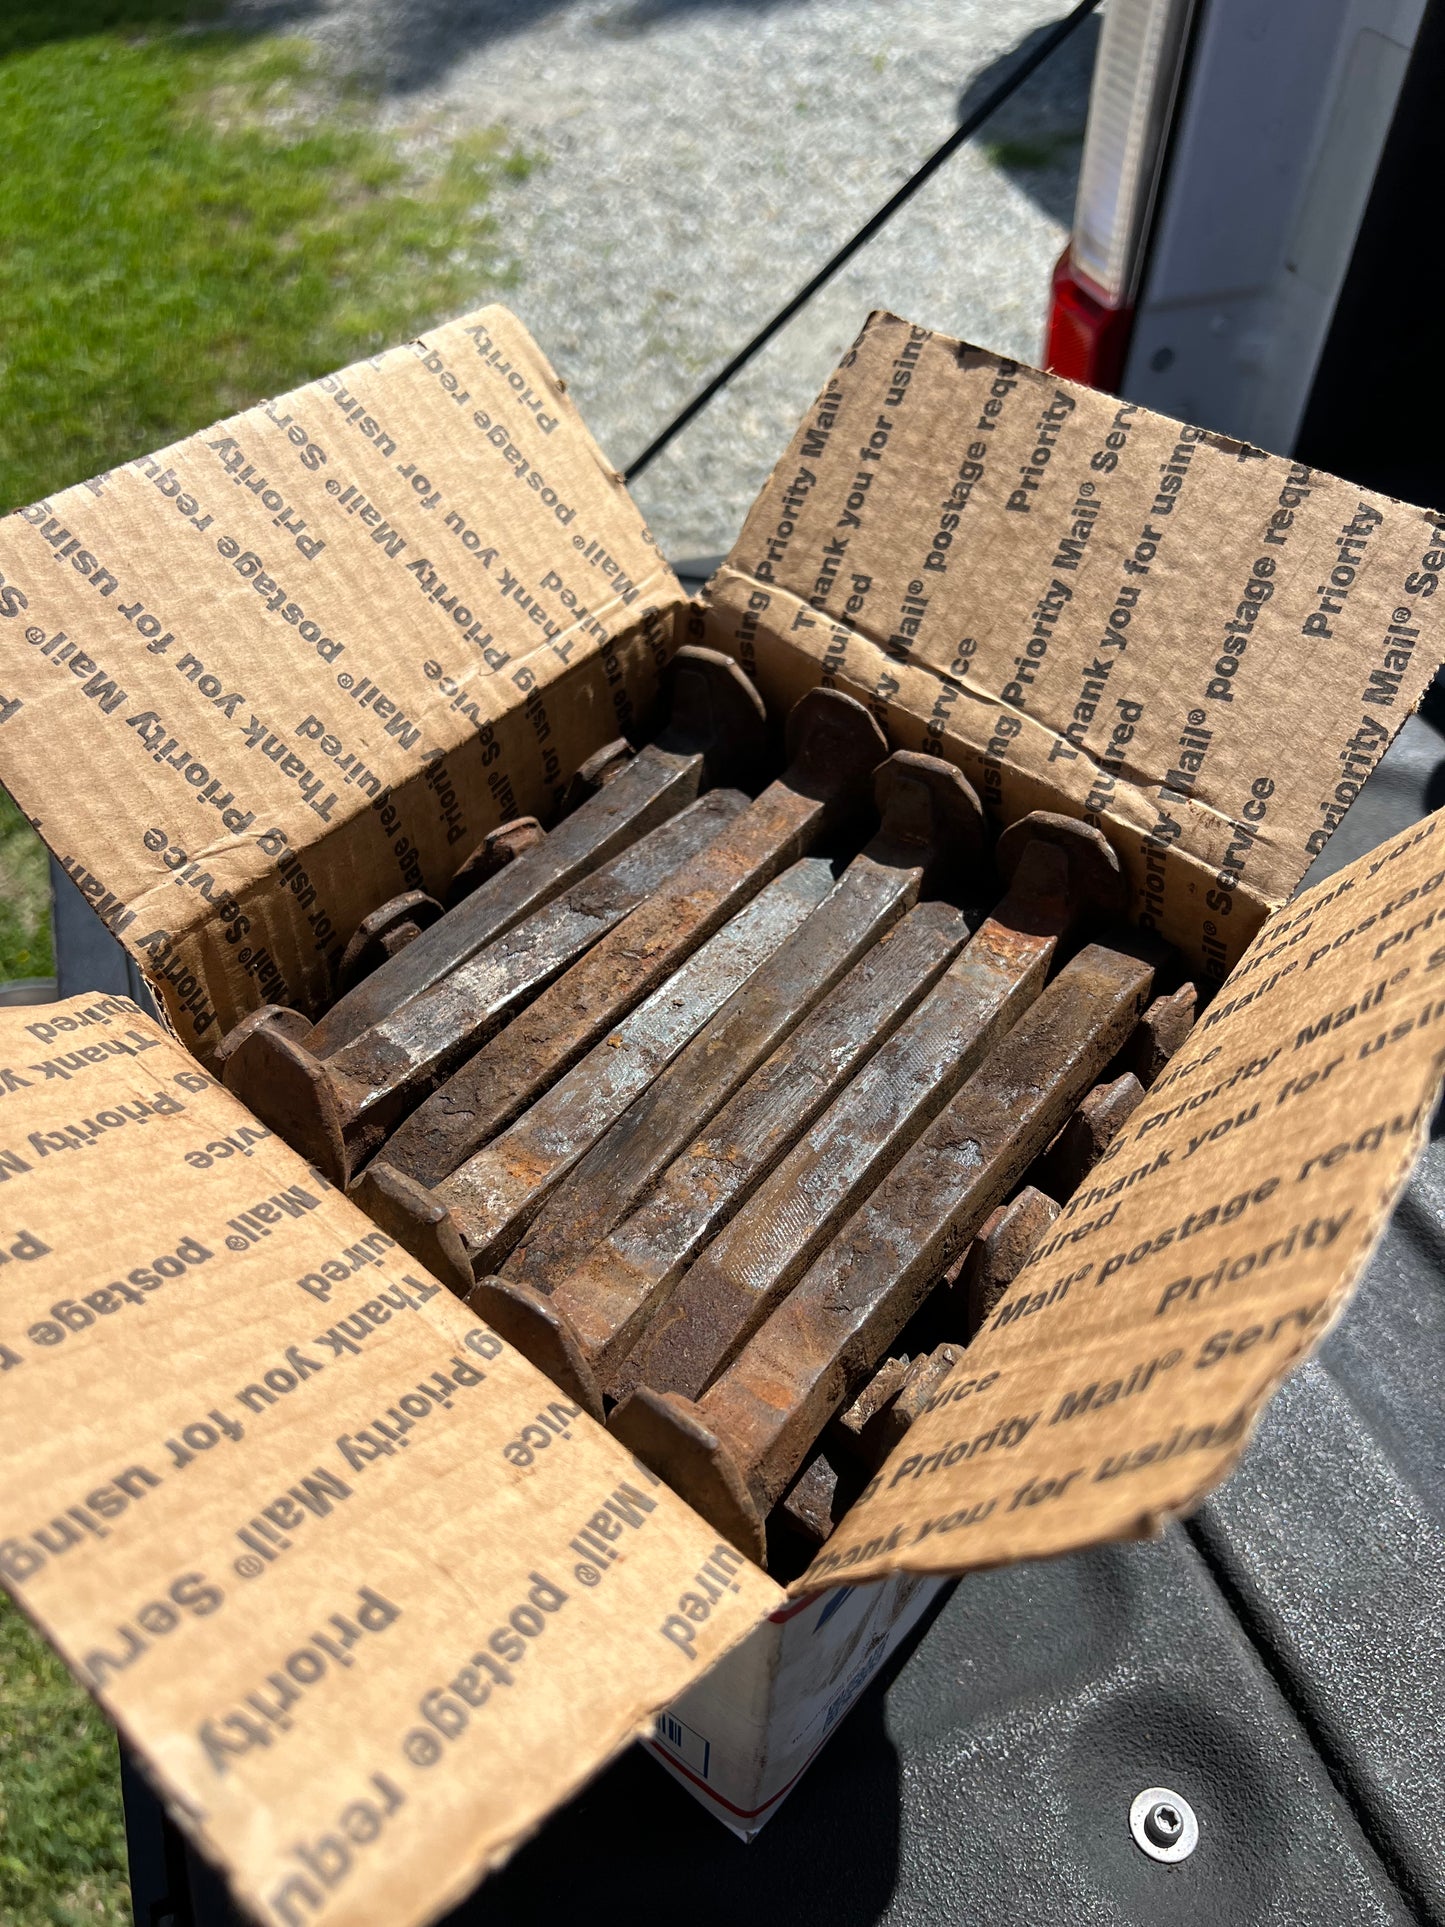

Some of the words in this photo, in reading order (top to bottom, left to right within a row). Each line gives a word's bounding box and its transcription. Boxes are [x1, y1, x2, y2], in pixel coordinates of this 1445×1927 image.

[465, 324, 560, 435] Priority
[837, 472, 874, 529] you
[860, 415, 893, 461] for
[885, 325, 932, 407] using
[208, 437, 326, 560] Priority
[396, 463, 443, 510] for
[473, 409, 577, 526] postage
[1005, 389, 1077, 513] Priority
[444, 510, 500, 569] you
[755, 467, 817, 583] Priority
[923, 441, 987, 572] postage
[217, 536, 345, 664] postage
[406, 557, 512, 672] Priority
[496, 568, 576, 665] Thank
[1049, 657, 1114, 764] Thank
[1101, 586, 1140, 650] you
[1124, 524, 1162, 575] for
[1150, 424, 1206, 516] using
[1301, 502, 1384, 640] Priority
[118, 602, 175, 654] for
[1000, 579, 1073, 707] Priority
[1204, 556, 1277, 702] postage
[175, 653, 246, 719] you
[423, 659, 500, 767] Service
[125, 711, 257, 835] Priority
[240, 715, 339, 822] Thank
[144, 828, 250, 944] Service
[256, 828, 319, 910] using
[1366, 822, 1437, 879] you
[135, 929, 217, 1036] Priority
[27, 1030, 161, 1080] Thank
[1135, 1047, 1283, 1142] Priority
[27, 1091, 186, 1158] Priority
[1063, 1148, 1176, 1220] Thank
[1181, 1102, 1261, 1159] you
[1276, 1055, 1345, 1105] for
[1096, 1176, 1280, 1287] postage
[1154, 1207, 1352, 1317] Priority
[27, 1236, 215, 1346] postage
[314, 1273, 443, 1357] Thank
[235, 1345, 326, 1414] you
[336, 1355, 487, 1473] Priority
[164, 1408, 245, 1469] for
[887, 1411, 1043, 1489] Priority
[913, 1497, 999, 1545] you
[1005, 1466, 1086, 1513] for
[199, 1585, 402, 1775] Priority
[402, 1570, 570, 1767] postage
